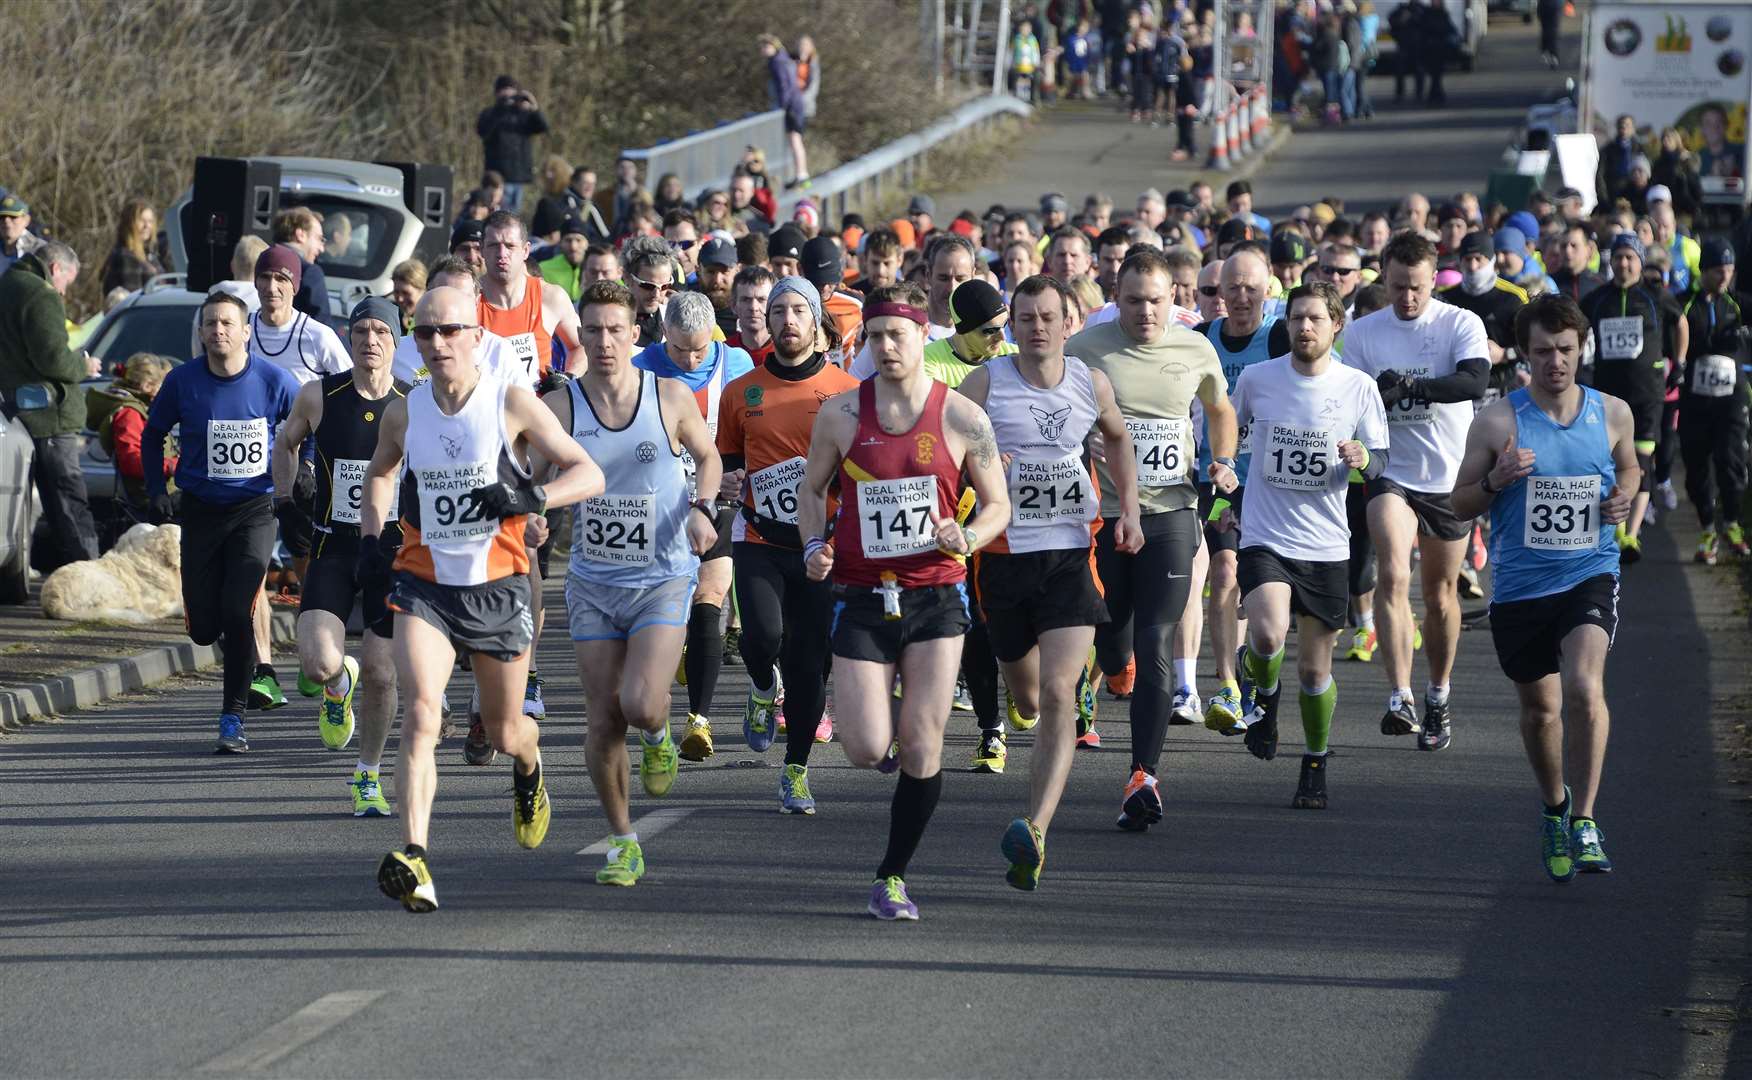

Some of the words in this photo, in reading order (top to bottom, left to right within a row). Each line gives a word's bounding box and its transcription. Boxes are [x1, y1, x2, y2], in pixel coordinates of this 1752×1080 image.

[1608, 332, 1639, 349] 153
[1126, 422, 1152, 431] DEAL
[1157, 423, 1180, 431] HALF
[1273, 426, 1298, 437] DEAL
[1303, 431, 1329, 439] HALF
[213, 432, 262, 440] MARATHON
[1131, 433, 1180, 441] ARATHON
[1272, 436, 1328, 448] MARATHON
[213, 442, 262, 465] 308
[341, 463, 366, 473] DEAL
[1020, 463, 1049, 472] DEAL
[1272, 448, 1327, 477] 135
[213, 467, 232, 475] DEAL
[422, 471, 451, 481] DEAL
[455, 464, 485, 478] HALF
[754, 472, 776, 485] DEAL
[777, 460, 802, 475] HALF
[1019, 469, 1081, 482] MARATHON
[425, 478, 486, 491] MARATHON
[757, 469, 806, 494] MARATHON
[1267, 475, 1288, 484] DEAL
[1291, 478, 1302, 486] TRI
[1535, 481, 1565, 490] DEAL
[1570, 480, 1595, 490] HALF
[865, 485, 894, 495] DEAL
[900, 480, 929, 492] HALF
[762, 482, 802, 520] 16
[866, 492, 930, 506] MARATHON
[1019, 481, 1084, 509] 214
[1535, 491, 1594, 500] MARATHON
[587, 497, 614, 508] DEAL
[619, 499, 648, 508] HALF
[337, 511, 358, 519] DEAL
[435, 493, 482, 526] 92
[586, 506, 648, 518] MARATHON
[1020, 512, 1043, 520] DEAL
[1046, 511, 1058, 520] TRI
[1061, 507, 1084, 516] CLUB
[868, 505, 931, 540] 147
[1531, 504, 1591, 533] 331
[427, 530, 450, 540] DEAL
[453, 529, 467, 538] TRI
[469, 525, 494, 536] CLUB
[586, 518, 649, 550] 324
[868, 544, 892, 553] DEAL
[896, 542, 909, 551] TRI
[912, 539, 935, 549] CLUB
[1531, 536, 1555, 545] DEAL
[1573, 536, 1593, 544] CLUB
[586, 548, 608, 558] DEAL
[610, 553, 624, 561] TRI
[626, 554, 649, 563] CLUB
